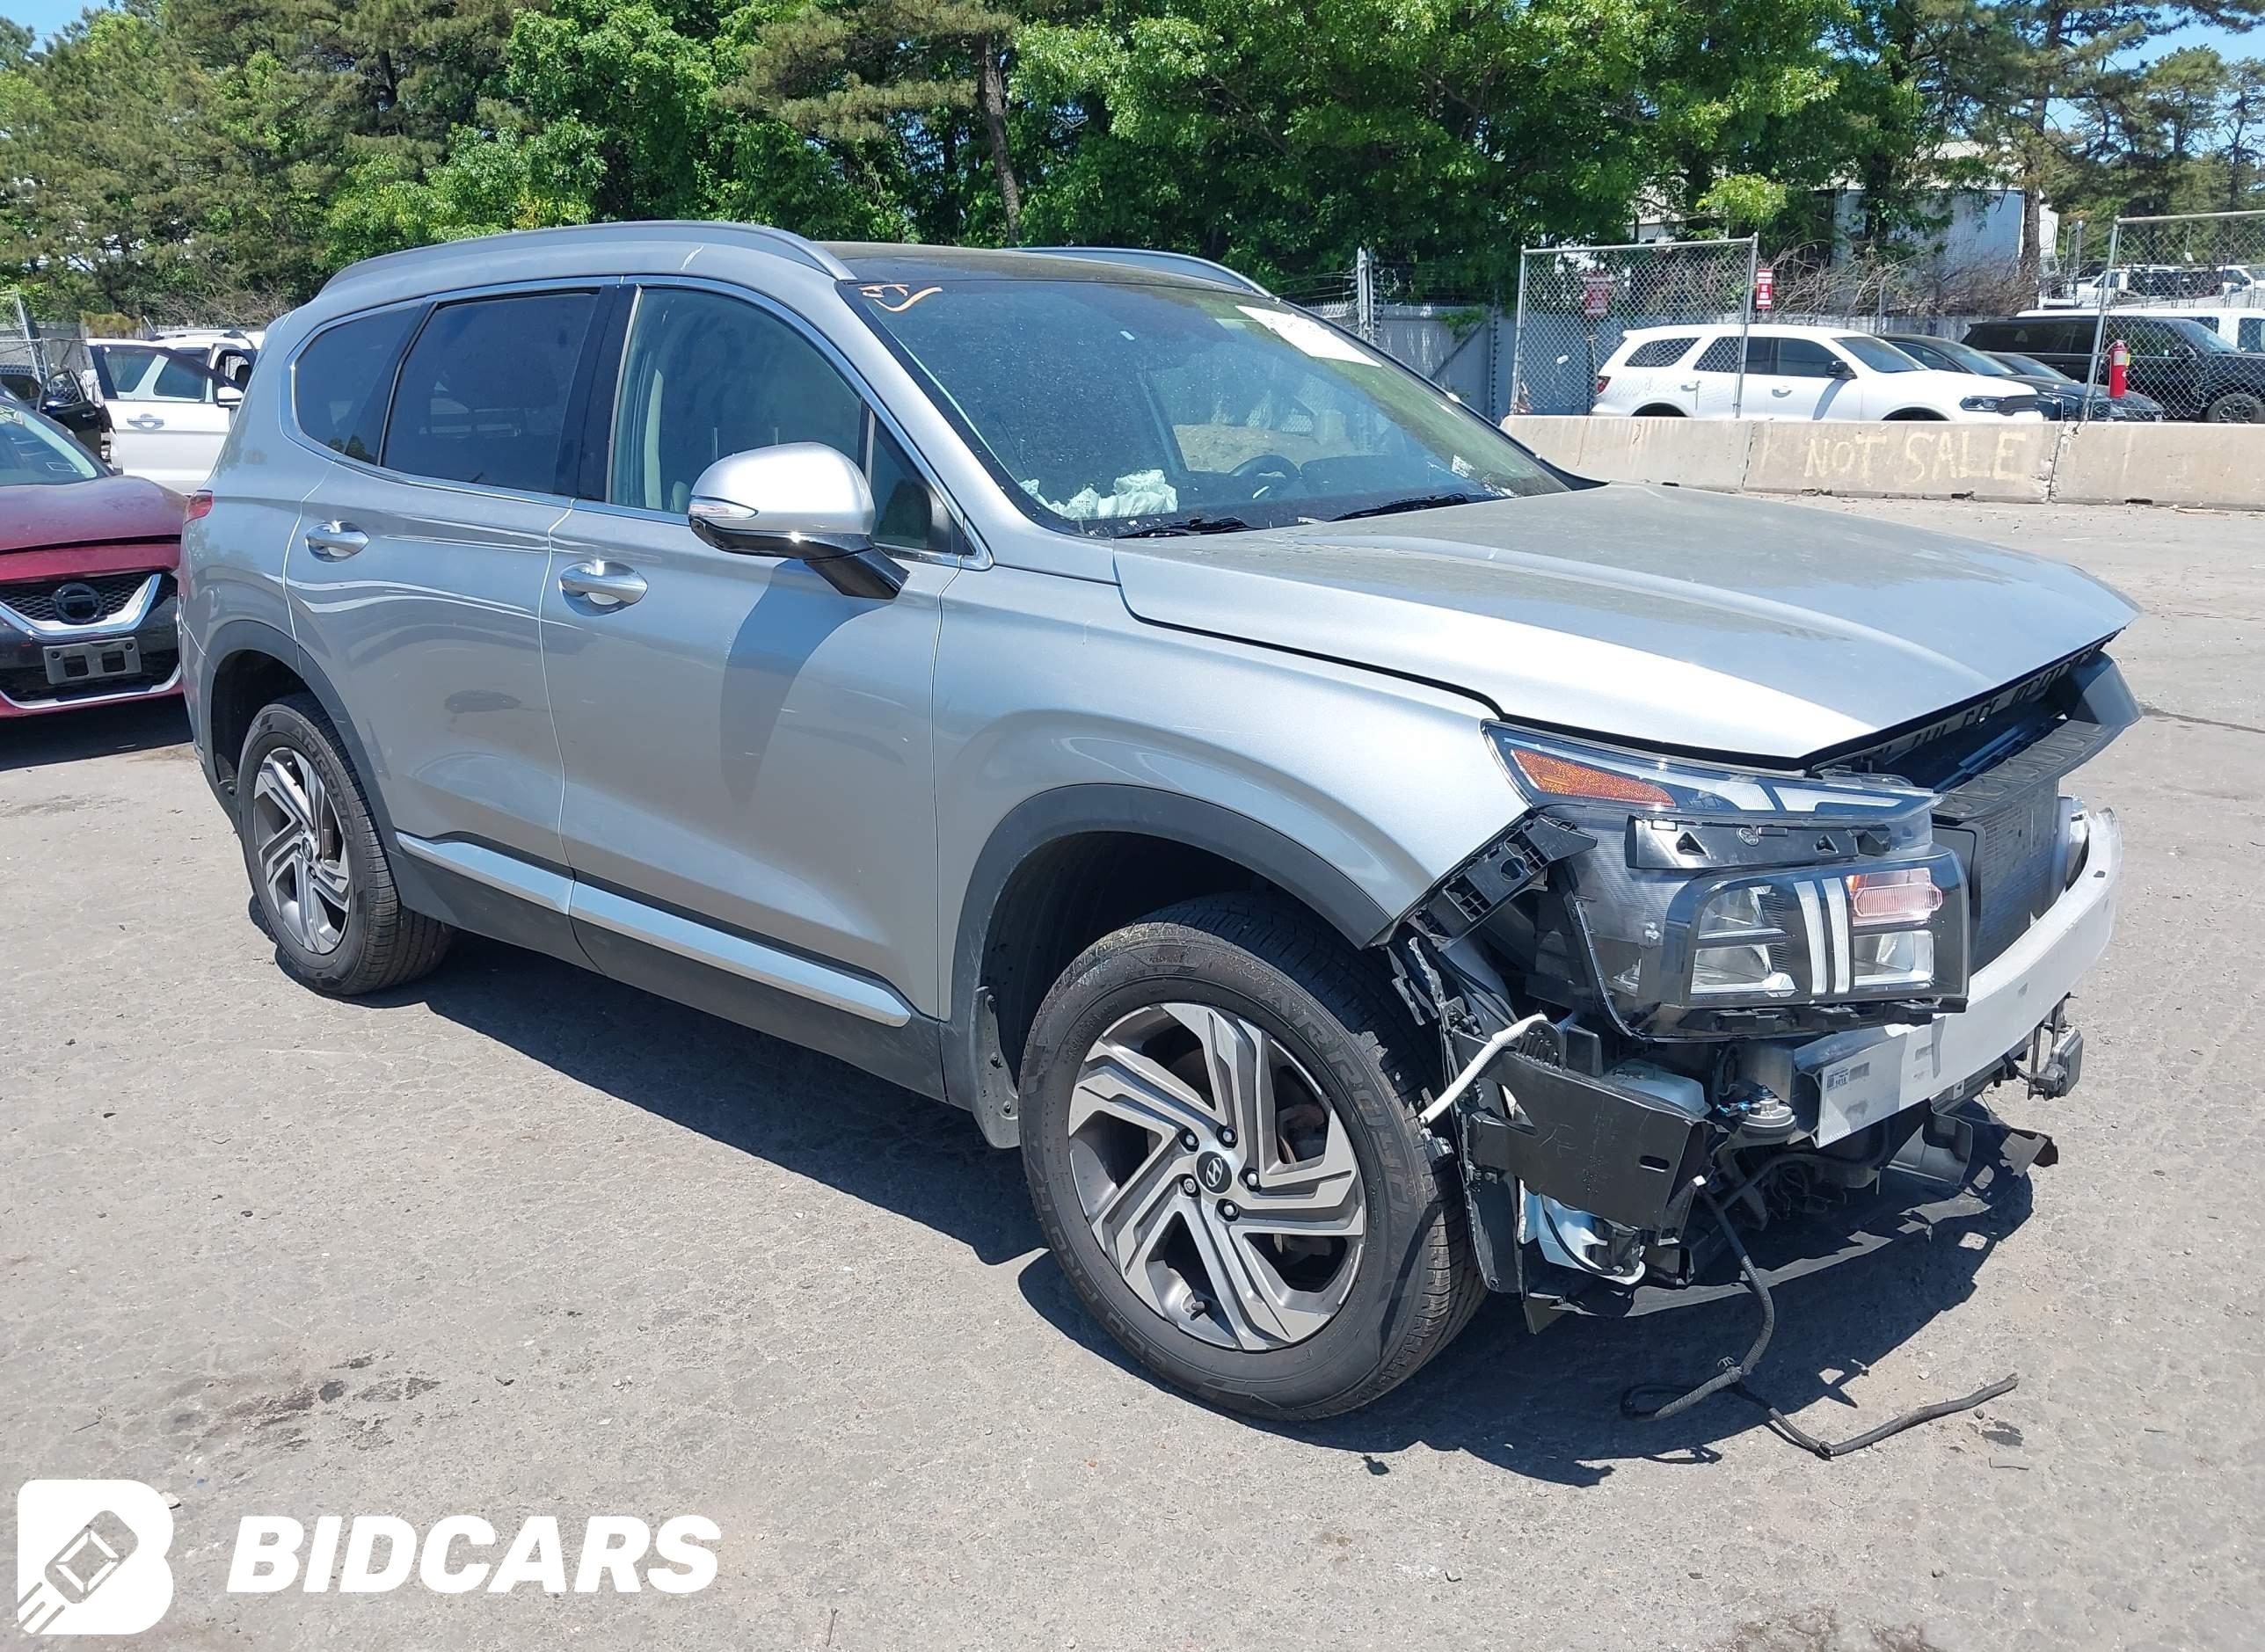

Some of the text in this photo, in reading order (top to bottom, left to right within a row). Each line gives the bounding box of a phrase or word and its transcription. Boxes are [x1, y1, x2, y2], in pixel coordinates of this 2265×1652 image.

[1803, 431, 2027, 484] NOT SALE
[1258, 989, 1410, 1213] ARROYO
[1051, 1226, 1099, 1302] PRO
[1107, 1311, 1168, 1365] ECO
